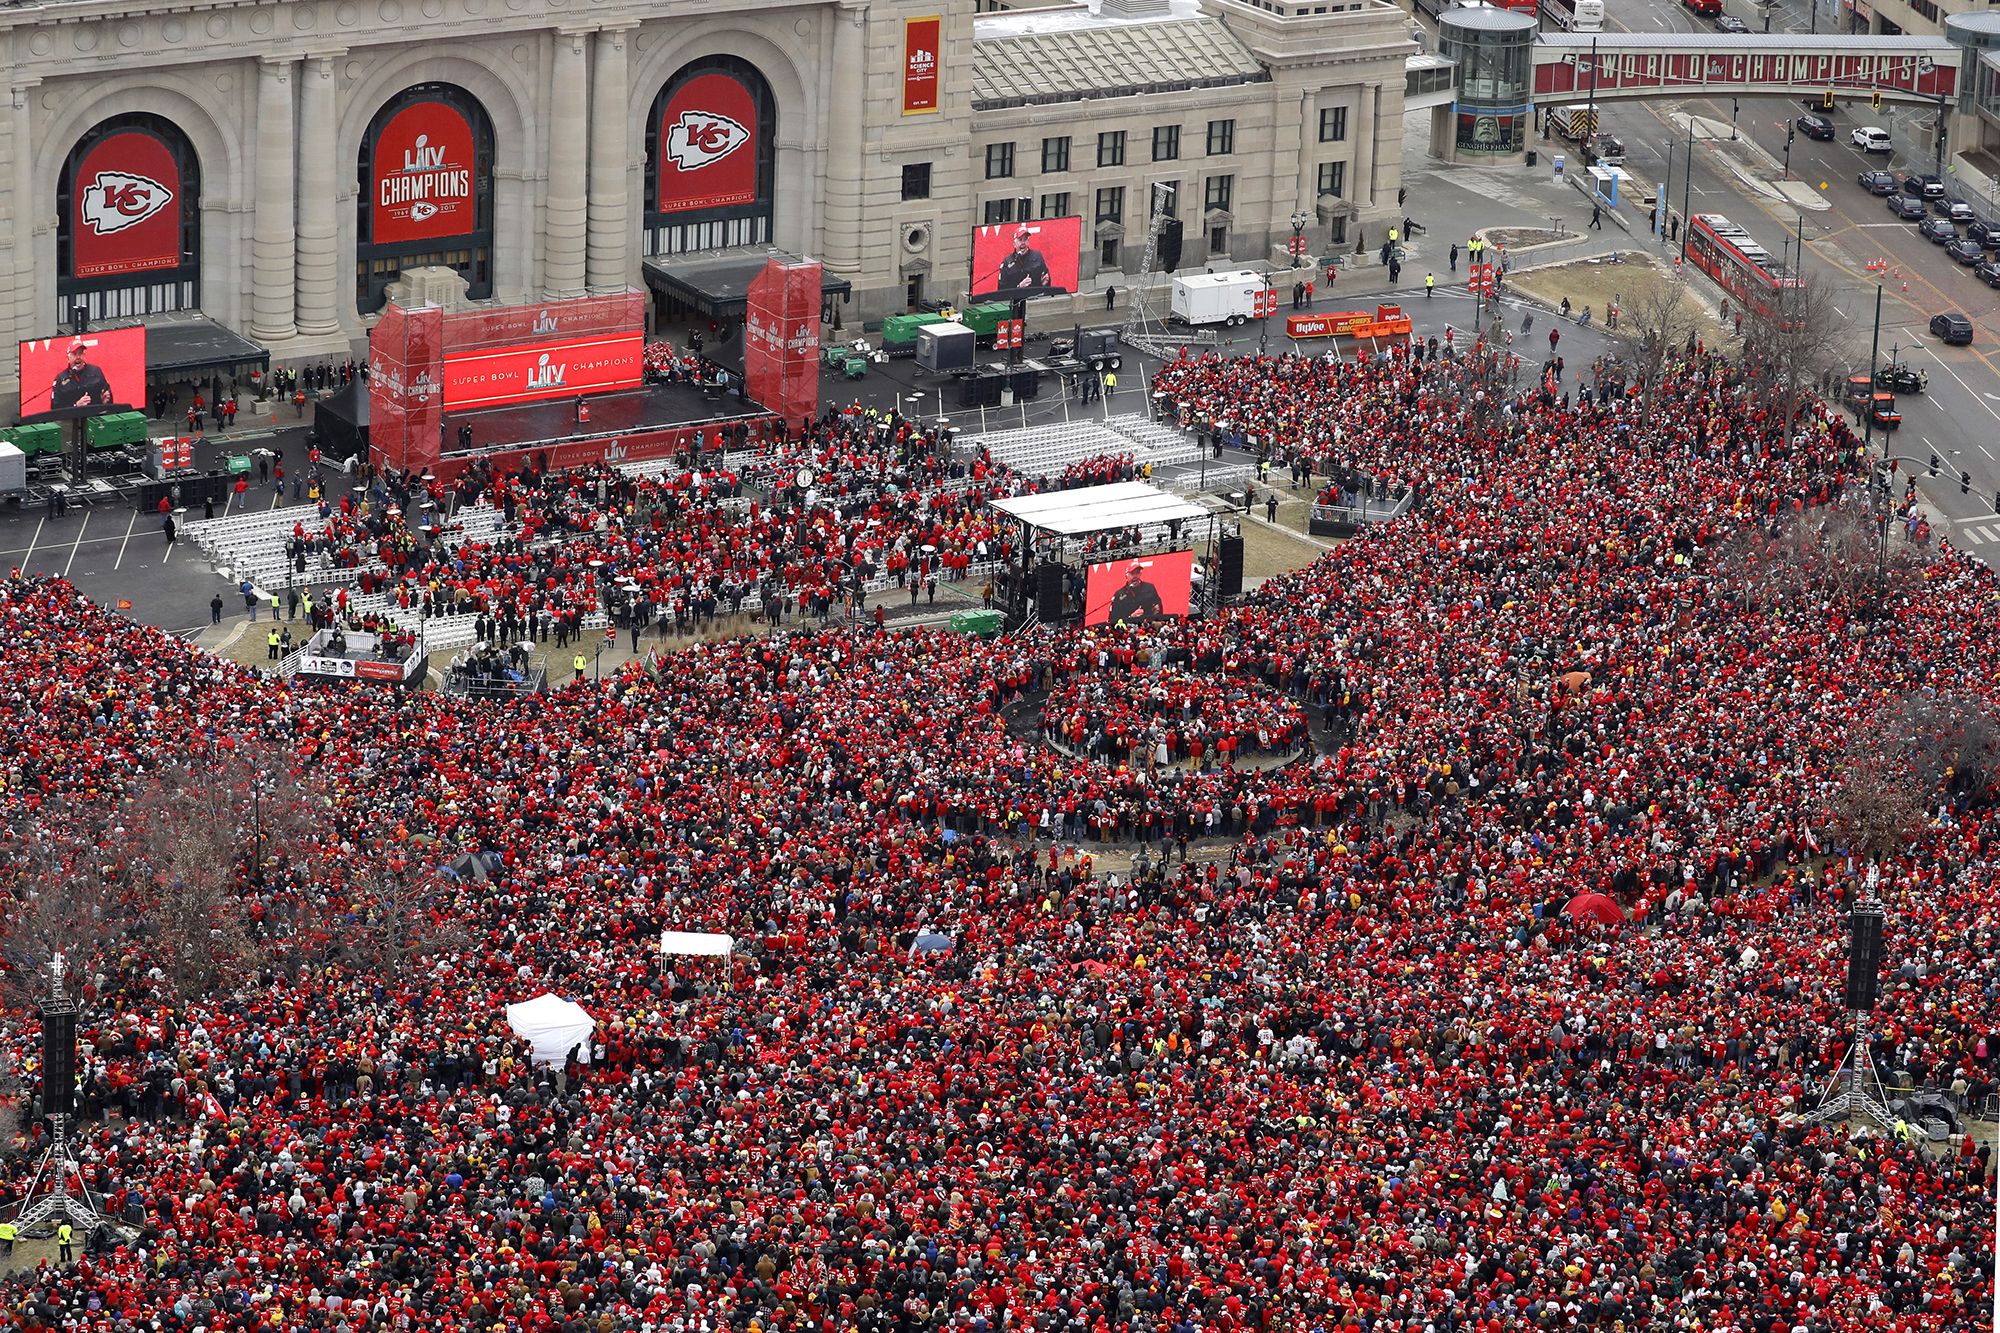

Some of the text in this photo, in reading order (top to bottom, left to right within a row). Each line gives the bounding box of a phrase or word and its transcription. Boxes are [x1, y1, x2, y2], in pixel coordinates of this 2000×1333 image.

[1602, 55, 1701, 78] WORLD
[1732, 56, 1911, 80] CHAMPIONS
[686, 122, 730, 154] KC
[1457, 142, 1489, 151] GENGHIS
[405, 146, 446, 170] LIV
[381, 170, 468, 206] CHAMPIONS
[104, 183, 150, 216] KC
[710, 194, 752, 202] CHAMPIONS
[132, 258, 176, 268] CHAMPIONS
[532, 317, 558, 334] LIV
[1296, 322, 1325, 334] HyVee
[452, 356, 634, 386] SUPER BOWL LIV CHAMPIONS
[408, 384, 440, 396] CHAMPIONS
[604, 446, 628, 460] LIV
[631, 441, 668, 450] CHAMPIONS
